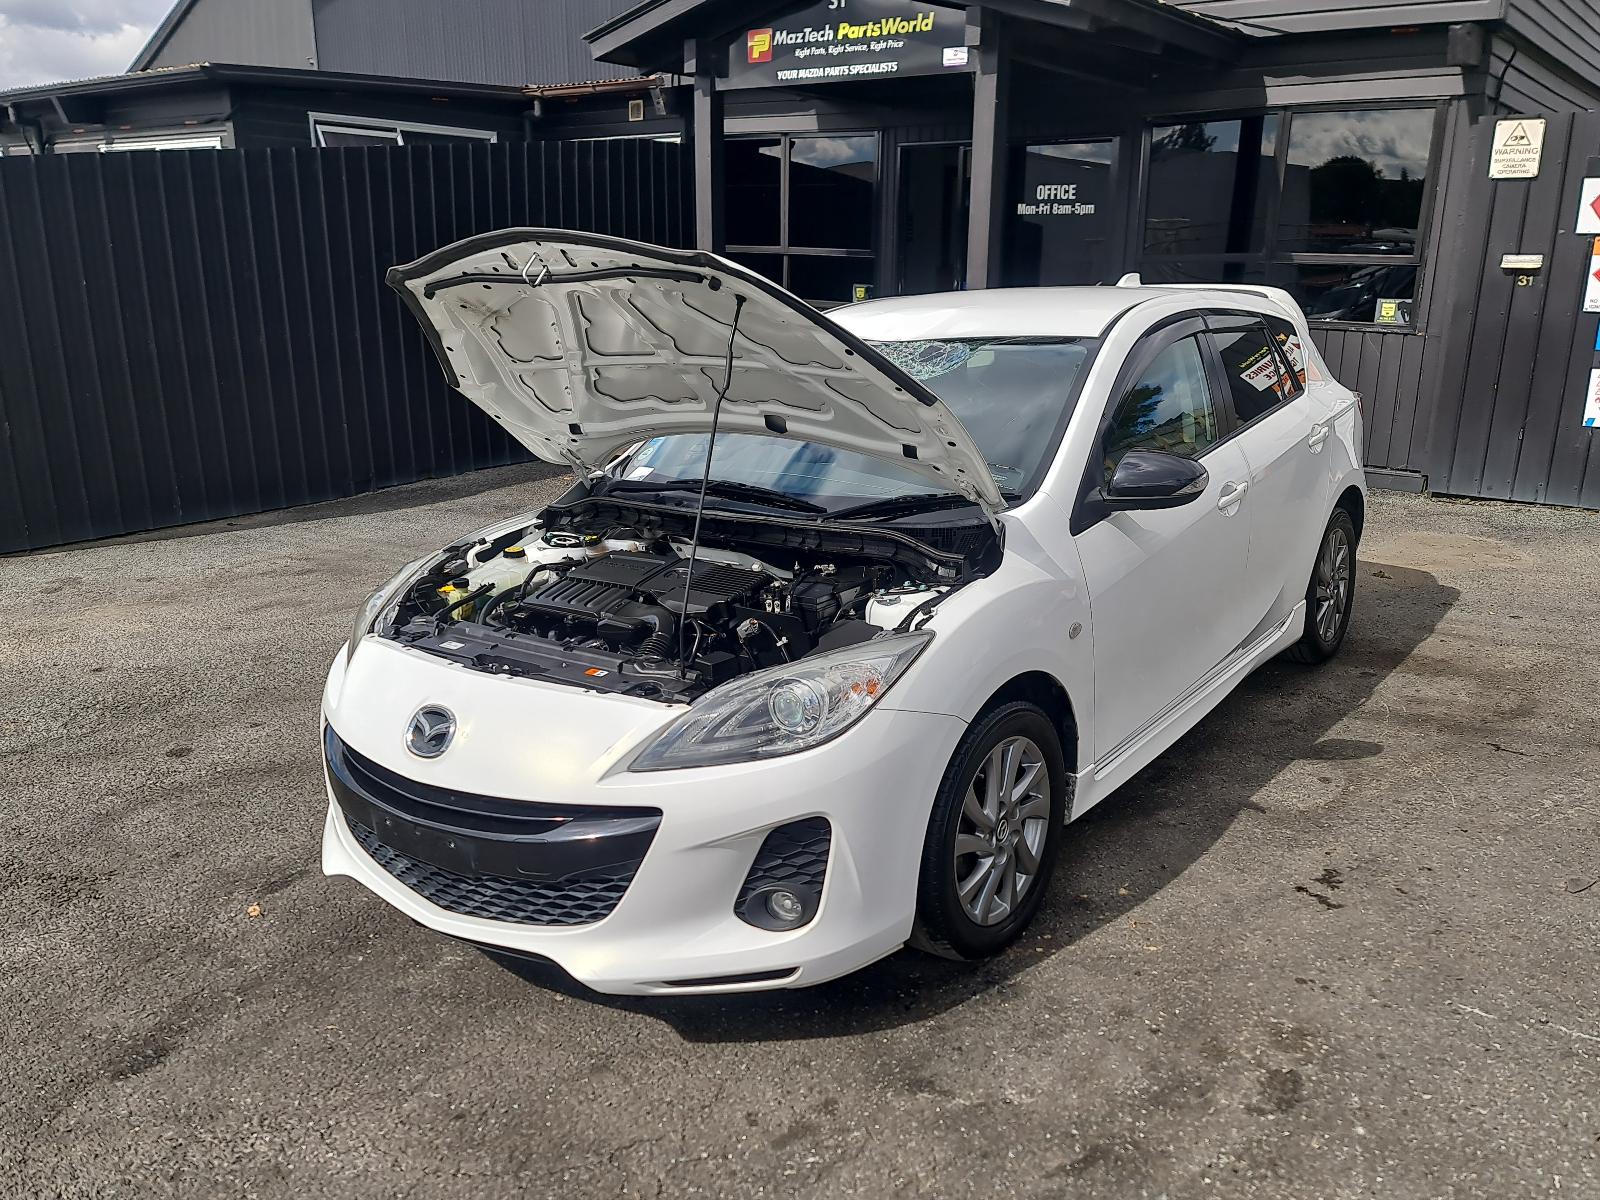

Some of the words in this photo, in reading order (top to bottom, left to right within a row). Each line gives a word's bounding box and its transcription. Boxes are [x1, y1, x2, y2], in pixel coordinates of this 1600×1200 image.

[773, 24, 834, 46] MazTech
[837, 11, 935, 40] PartsWorld
[795, 48, 810, 58] Right
[828, 45, 844, 55] Right
[844, 43, 869, 52] Service,
[870, 41, 887, 51] Right
[887, 40, 904, 48] Price
[777, 70, 799, 80] YOUR
[798, 68, 824, 79] MAZDA
[824, 66, 849, 76] PARTS
[849, 62, 898, 75] SPECIALISTS
[1494, 148, 1539, 156] WARNING
[1036, 184, 1077, 200] OFFICE
[1017, 203, 1050, 215] Mon-Fri
[1052, 203, 1095, 215] 8am-5pm
[1517, 275, 1534, 286] 31
